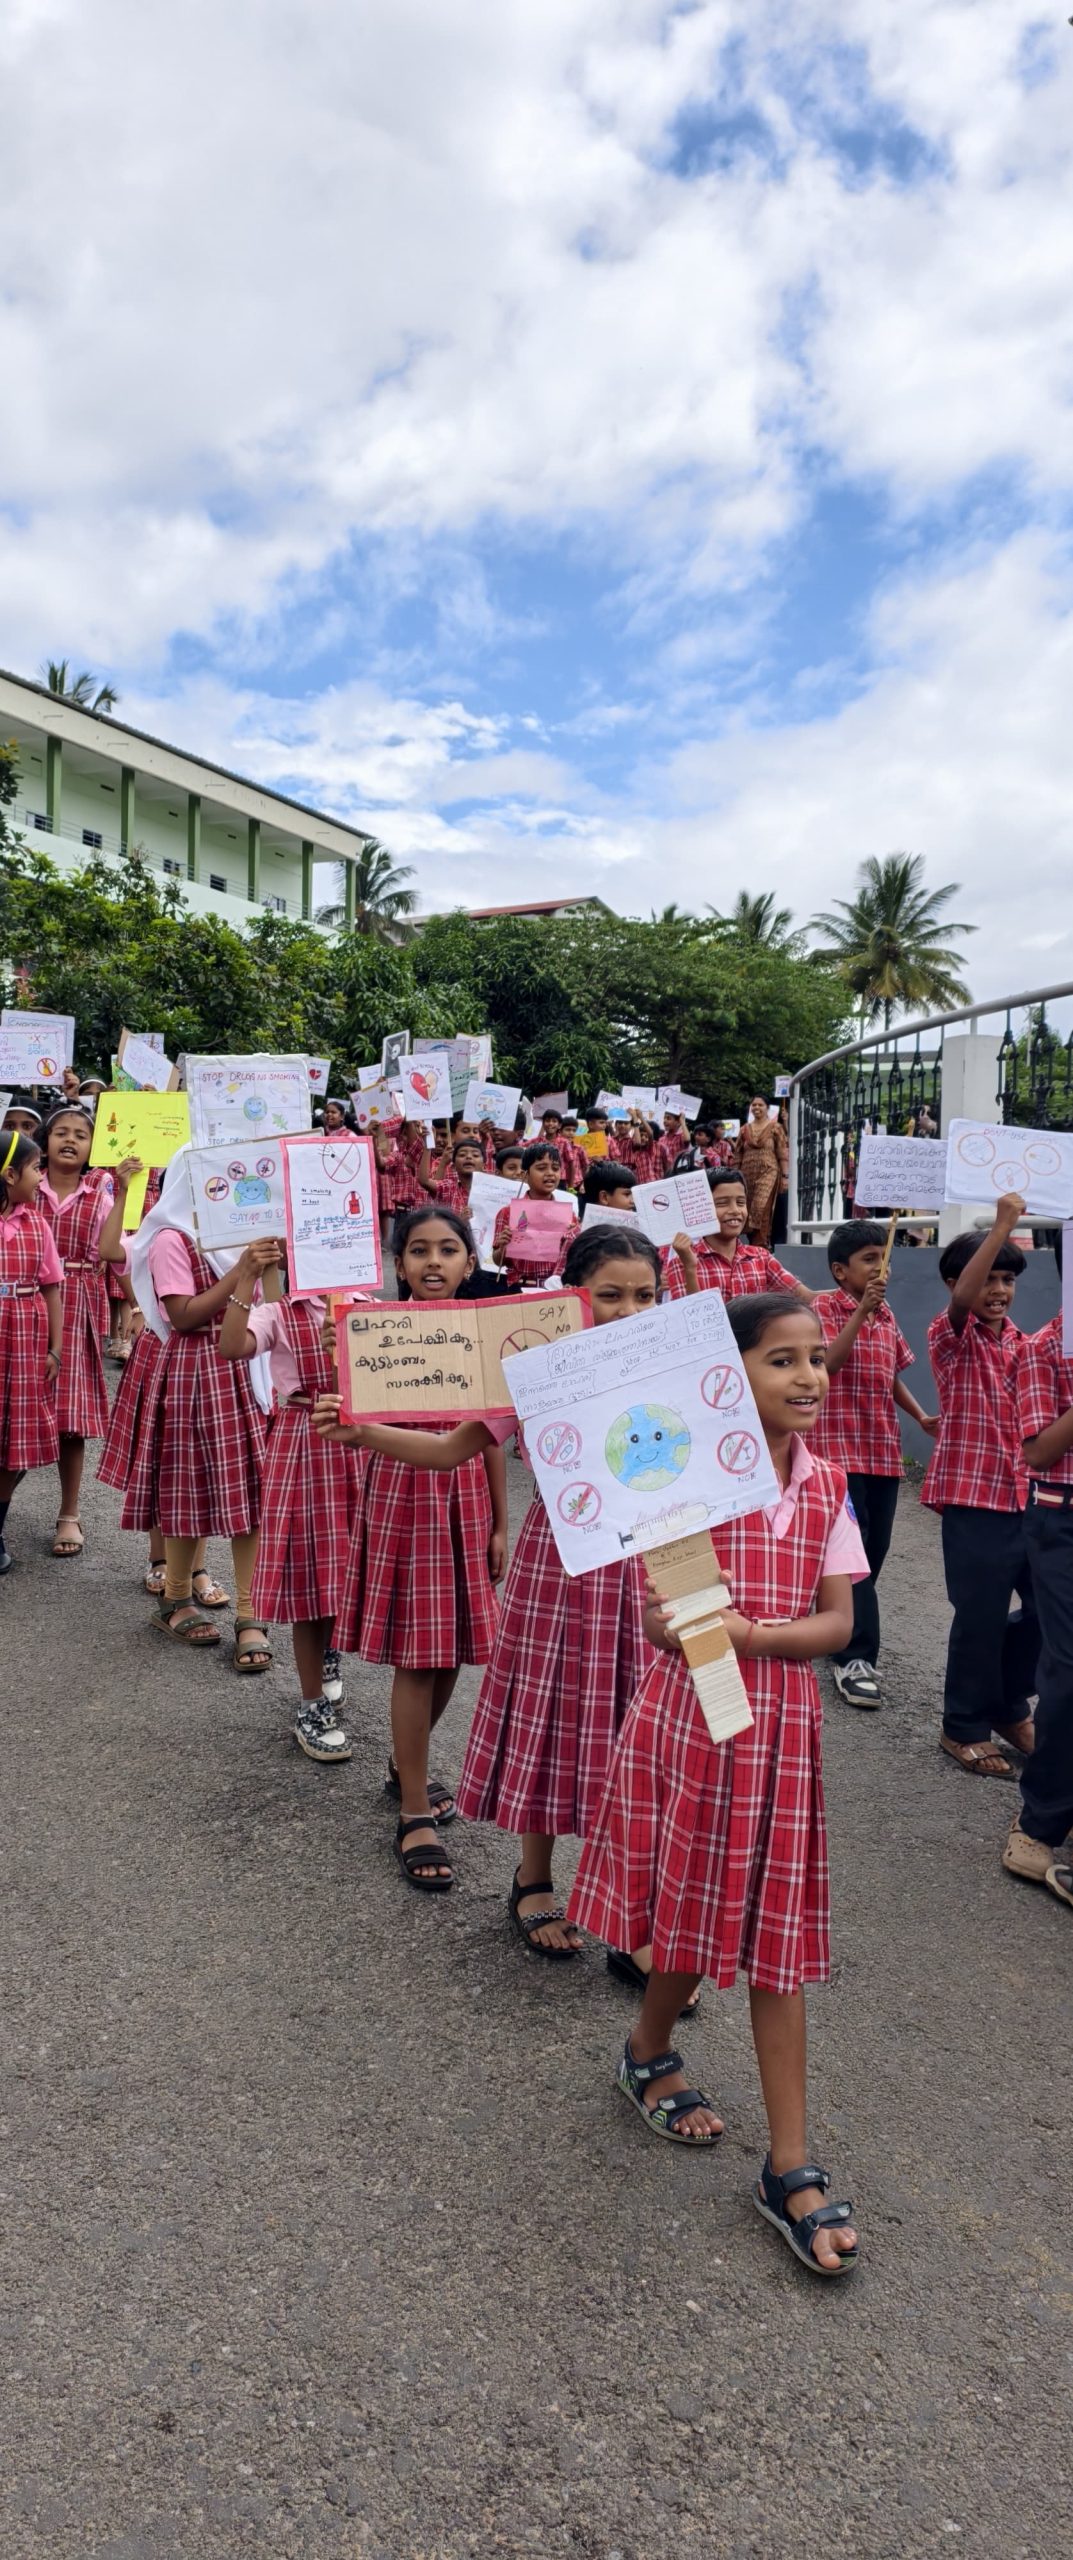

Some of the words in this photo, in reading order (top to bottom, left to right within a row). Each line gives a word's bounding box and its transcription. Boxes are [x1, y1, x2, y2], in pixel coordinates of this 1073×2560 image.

[202, 1072, 224, 1082] STOP
[229, 1071, 255, 1081] DRUGS
[229, 1212, 248, 1224] SAY
[538, 1305, 566, 1322] SAY
[686, 1306, 700, 1317] SAY
[703, 1302, 715, 1312] NO
[351, 1315, 413, 1333] ലഹരി
